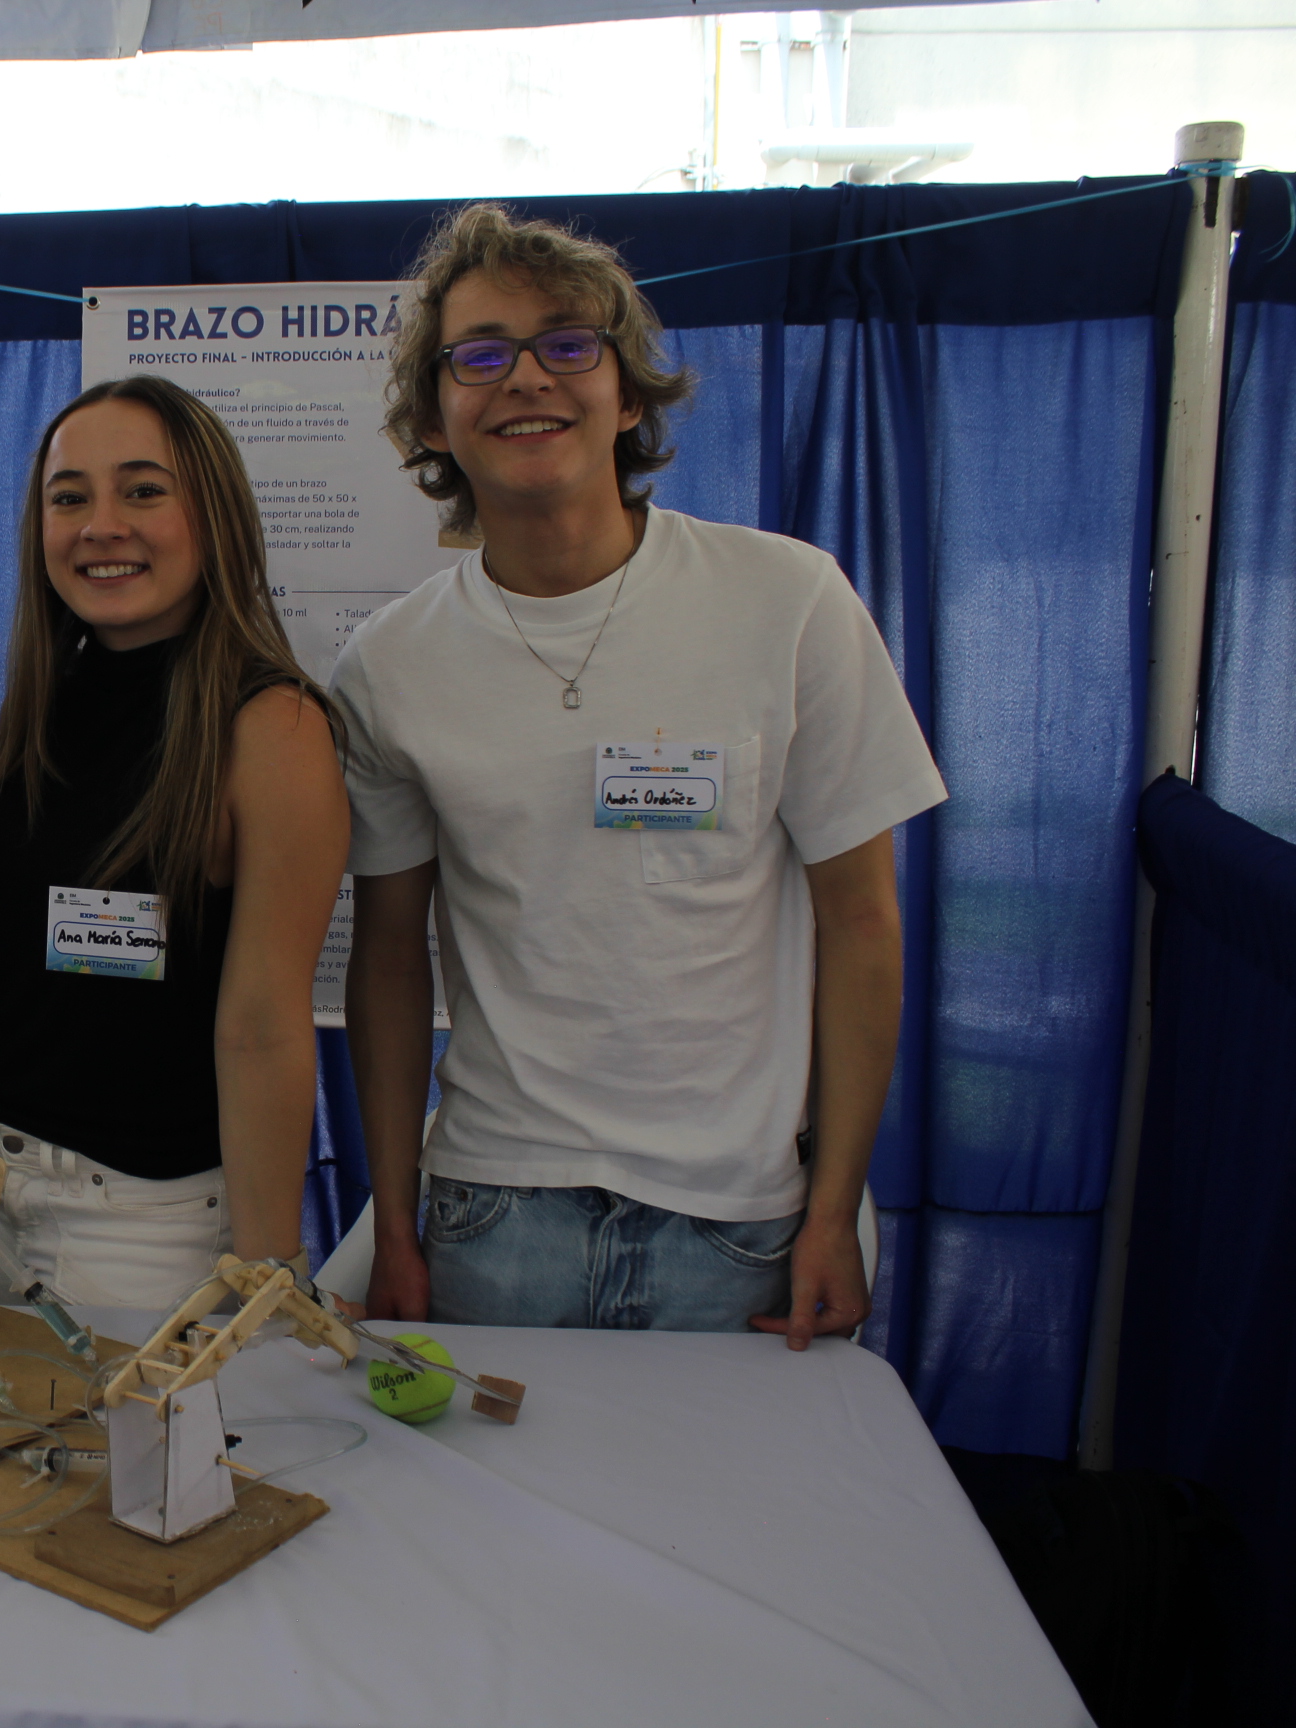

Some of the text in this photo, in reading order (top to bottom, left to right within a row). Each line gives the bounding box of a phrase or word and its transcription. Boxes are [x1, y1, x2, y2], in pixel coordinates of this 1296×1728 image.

[127, 294, 402, 341] BRAZO HIDRÁ
[129, 352, 198, 365] PROYECTO
[202, 351, 237, 364] FINAL
[251, 347, 352, 363] INTRODUCCIÓN
[356, 349, 365, 361] A
[369, 350, 385, 361] LA
[239, 403, 249, 412] el
[251, 402, 293, 414] principio
[295, 402, 307, 412] de
[309, 402, 345, 413] Pascal,
[237, 417, 249, 428] de
[251, 420, 263, 428] un
[265, 417, 294, 428] fluido
[295, 420, 302, 428] a
[304, 416, 334, 428] través
[336, 417, 349, 428] de
[247, 434, 285, 445] generar
[287, 432, 346, 443] movimiento.
[251, 479, 327, 490] tipo de un brazo
[298, 494, 310, 503] de
[312, 494, 326, 503] 50
[336, 494, 349, 503] 50
[261, 509, 360, 520] nsportar una bola de
[270, 525, 283, 533] 30
[284, 526, 302, 535] cm,
[304, 524, 355, 534] realizando
[265, 539, 351, 550] asladar y soltar la
[282, 608, 307, 618] 10 ml
[605, 788, 639, 805] Andrés
[624, 814, 693, 824] PARTICIPANTE
[79, 912, 135, 923] EXPOMECA 2025
[329, 914, 354, 924] eriale
[57, 928, 83, 944] Ana
[87, 930, 122, 947] María
[73, 958, 137, 972] PARTICIPANTE
[370, 1372, 417, 1391] Wilson
[389, 1388, 399, 1401] 2
